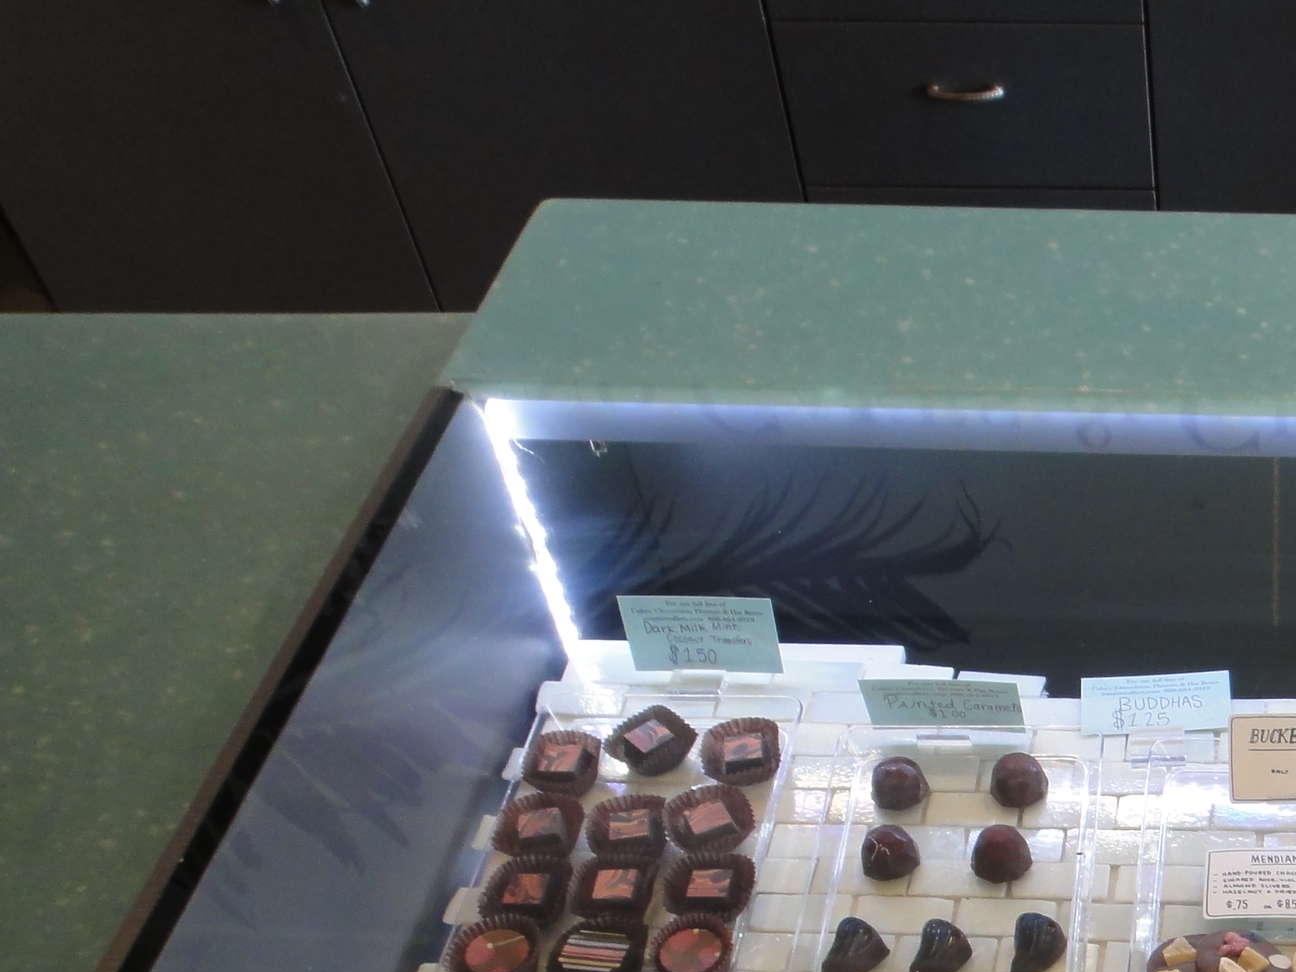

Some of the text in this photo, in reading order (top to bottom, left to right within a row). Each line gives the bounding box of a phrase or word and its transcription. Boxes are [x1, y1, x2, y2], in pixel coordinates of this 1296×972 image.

[643, 620, 675, 634] Dark
[680, 623, 707, 633] Milk
[667, 634, 704, 646] Coconut
[1118, 694, 1203, 712] BUDDHAS
